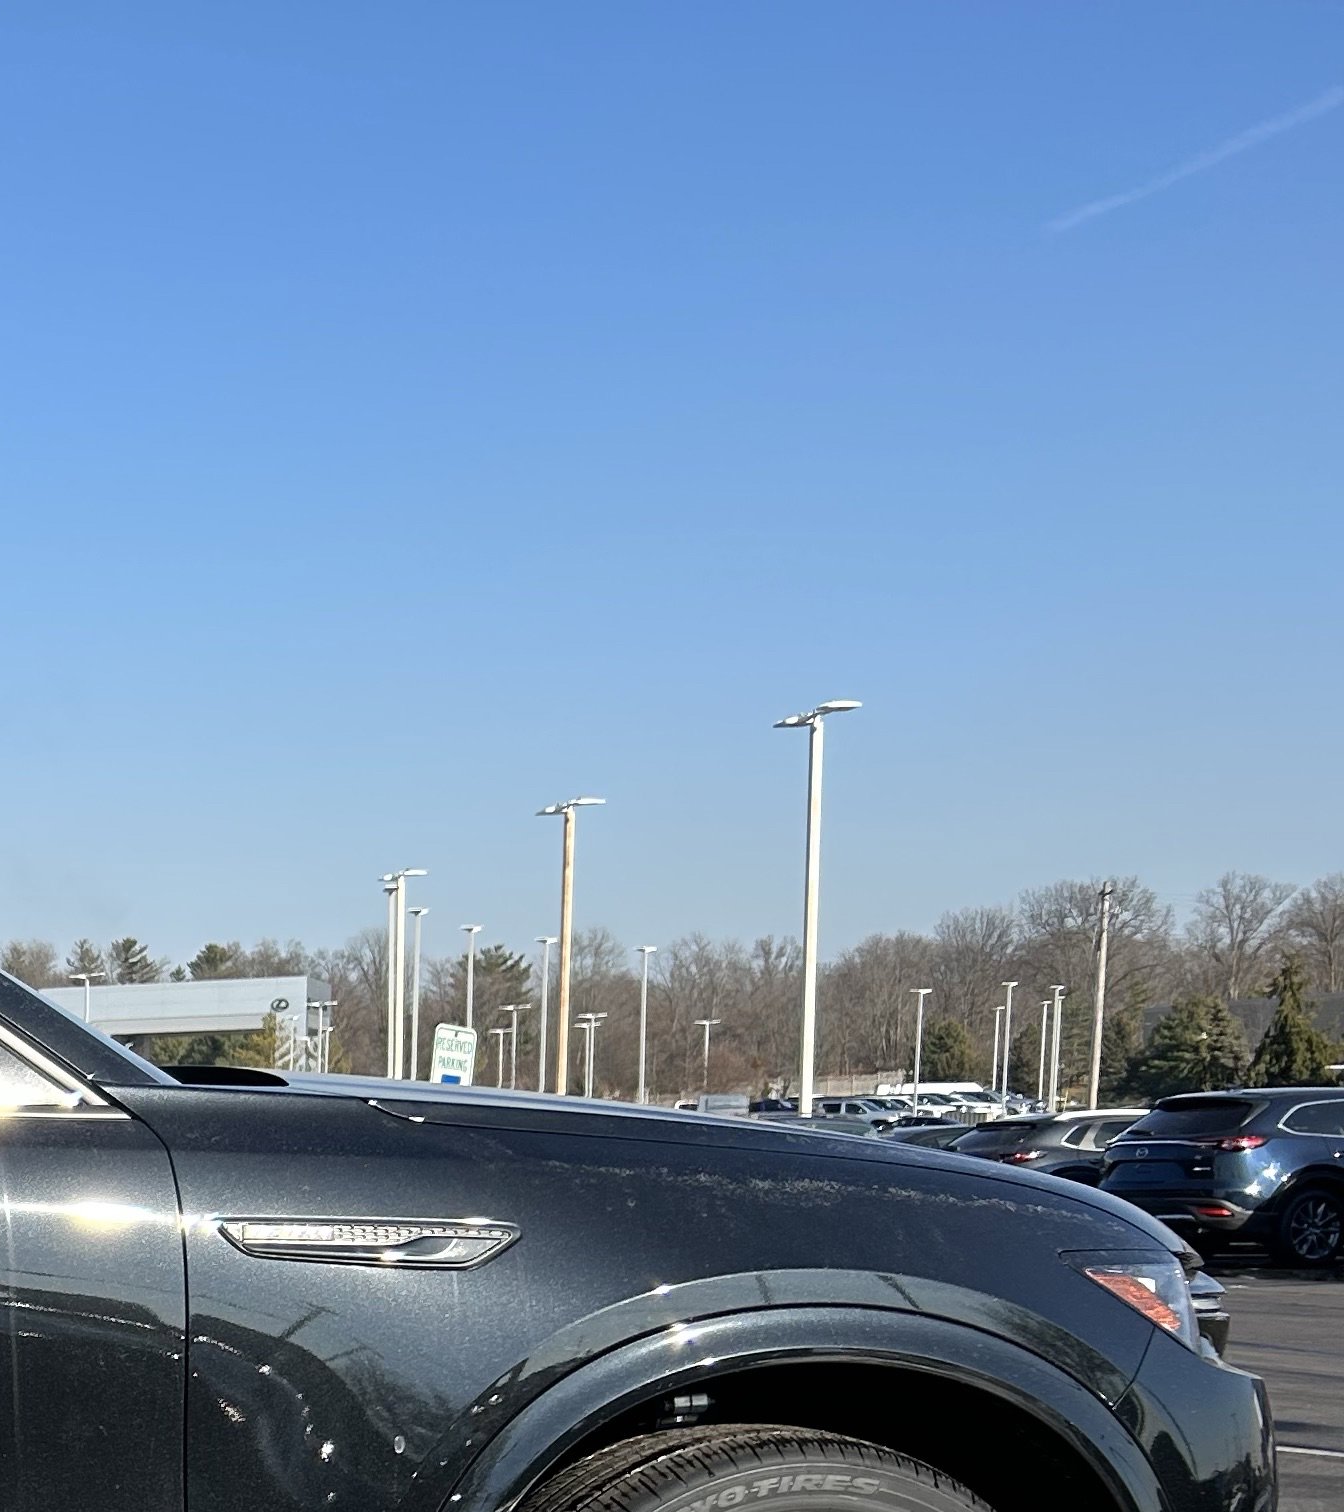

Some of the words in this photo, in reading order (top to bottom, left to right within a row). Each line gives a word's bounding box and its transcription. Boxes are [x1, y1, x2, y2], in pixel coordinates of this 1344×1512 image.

[436, 1036, 473, 1055] RESERVED
[438, 1055, 468, 1073] PARKING
[753, 1474, 881, 1497] TIRES
